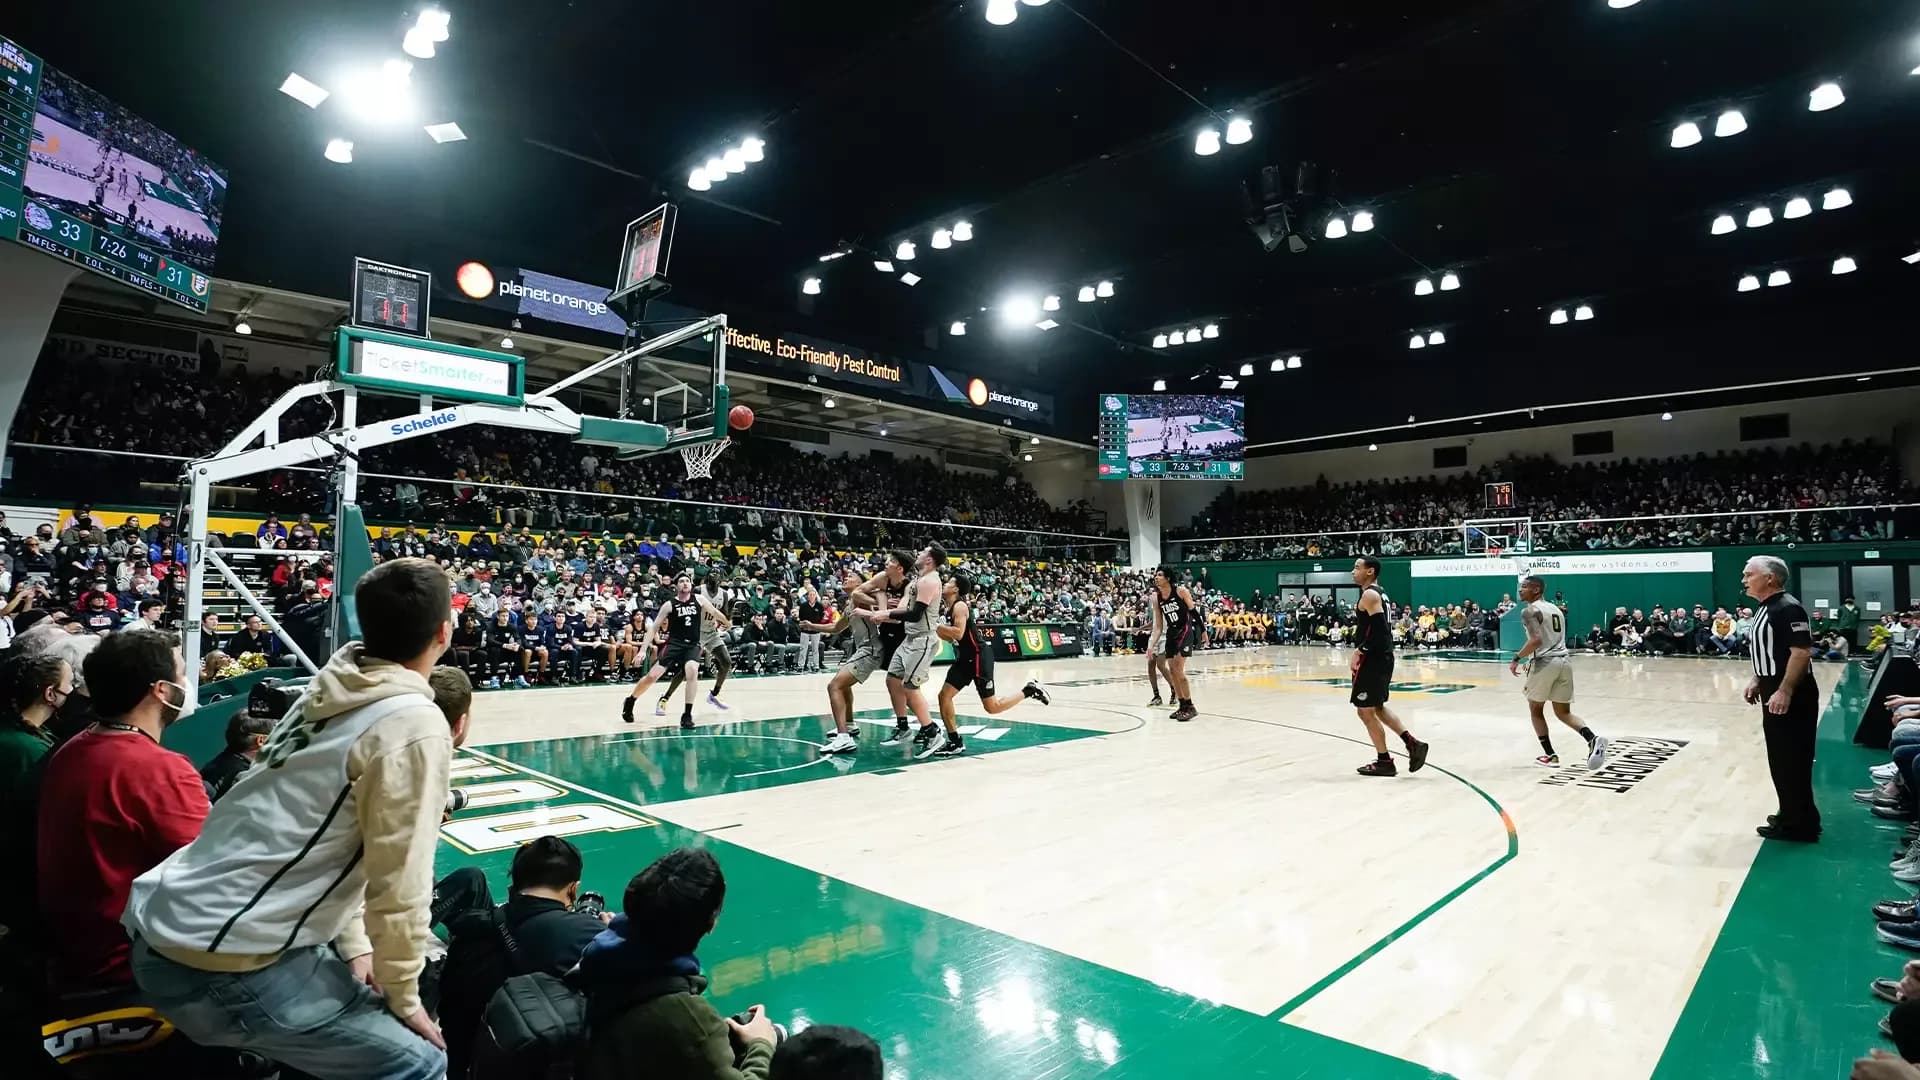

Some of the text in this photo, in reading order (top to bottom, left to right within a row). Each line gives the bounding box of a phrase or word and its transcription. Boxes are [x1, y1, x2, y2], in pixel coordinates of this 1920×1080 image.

[59, 219, 81, 241] 33
[26, 232, 40, 245] TM
[40, 239, 57, 252] FLS
[99, 235, 127, 259] 7:26
[167, 266, 183, 286] 31
[367, 264, 417, 279] DAKTRONICS
[499, 280, 607, 316] planet orange
[95, 344, 198, 371] SECTION
[726, 326, 900, 382] ffective, Eco-Friendly Pest Control
[988, 390, 1039, 412] planet orange
[391, 412, 457, 436] Schelde
[1149, 462, 1160, 472] 33
[1172, 462, 1190, 471] 7:26
[1211, 463, 1221, 472] 31
[675, 605, 697, 617] ZAGS
[1161, 601, 1180, 614] ZAGS
[1168, 612, 1179, 623] 10
[684, 616, 692, 626] 2
[1551, 613, 1562, 633] 0
